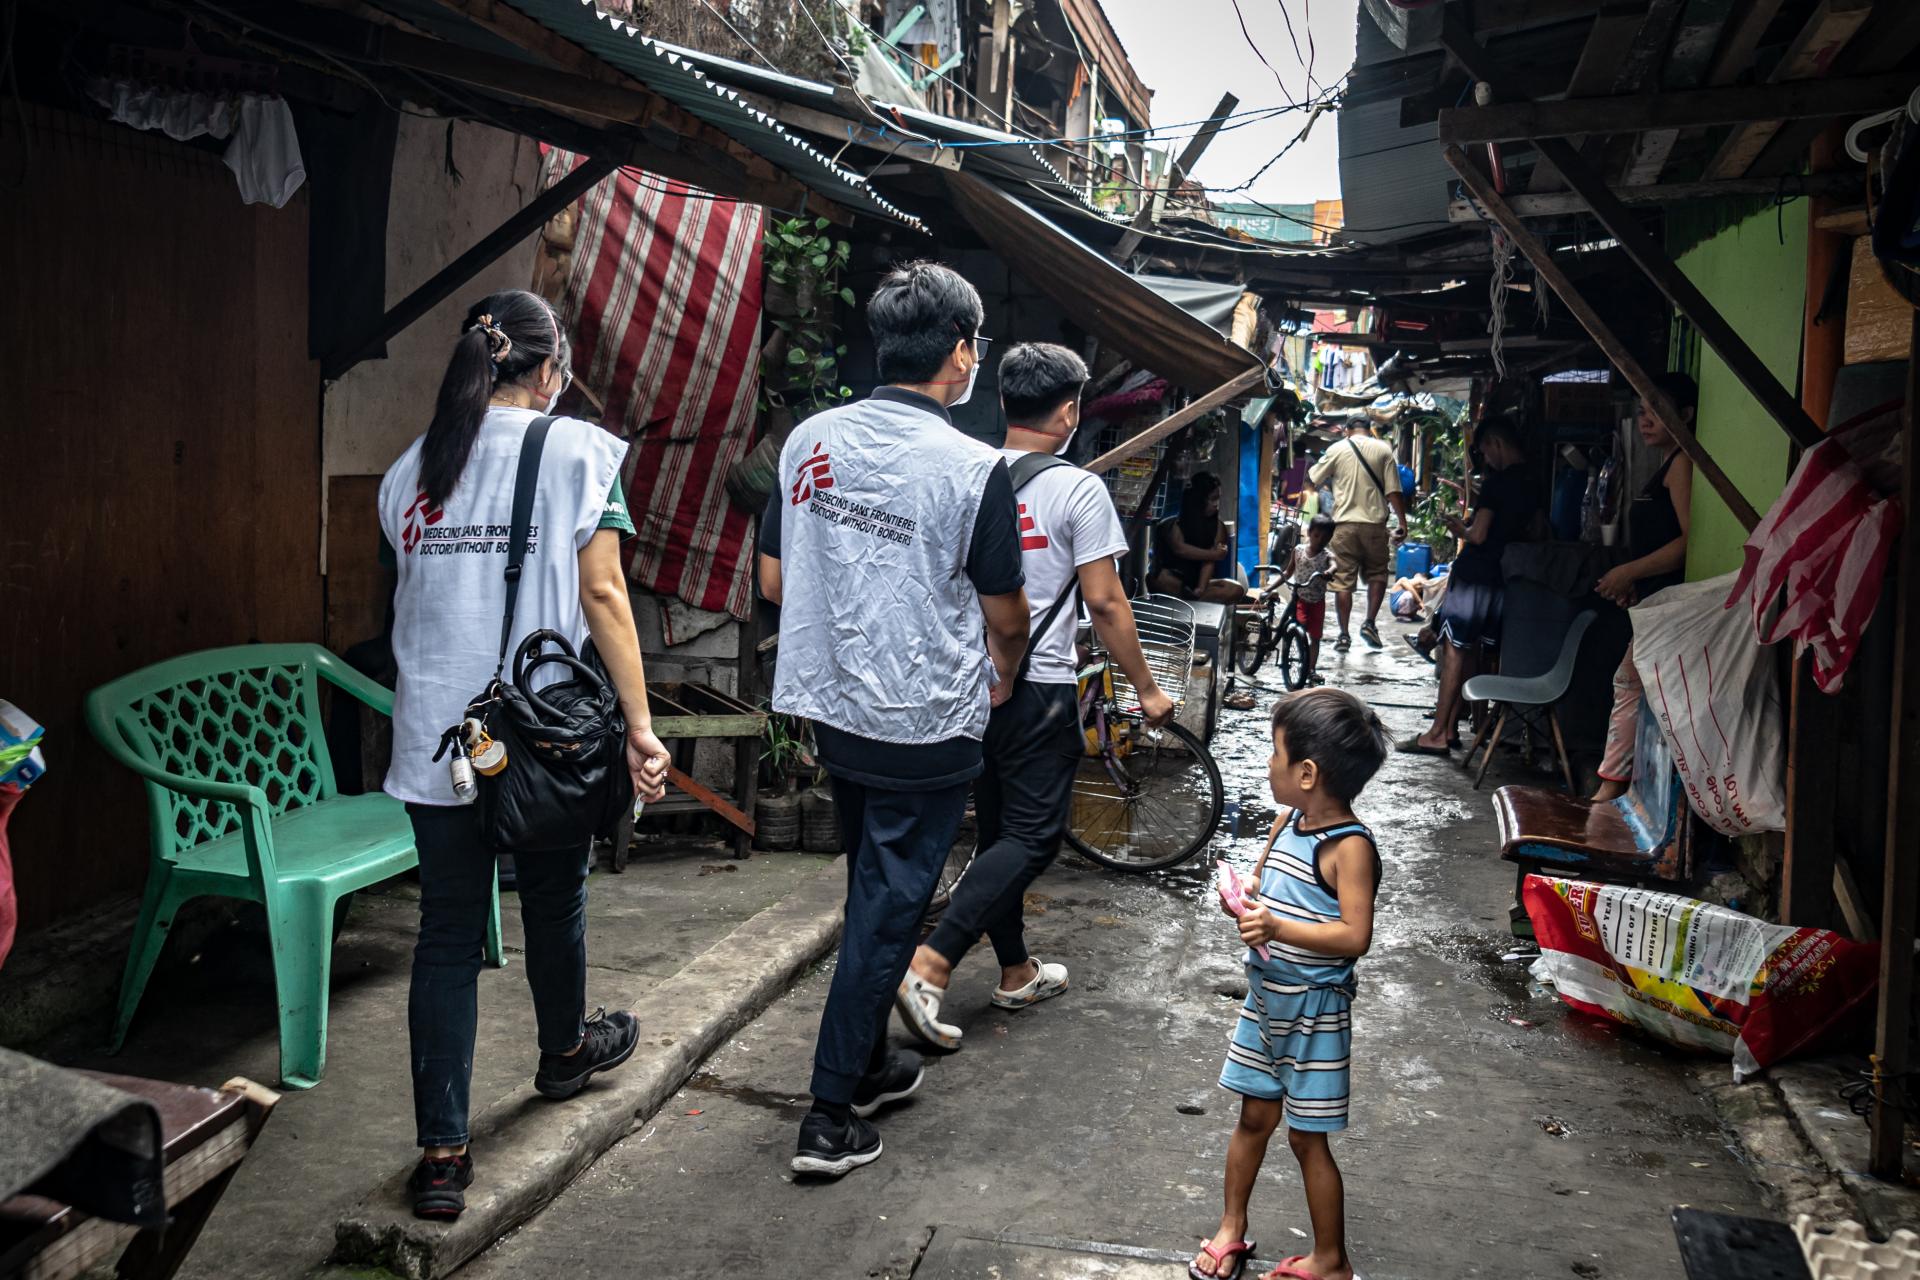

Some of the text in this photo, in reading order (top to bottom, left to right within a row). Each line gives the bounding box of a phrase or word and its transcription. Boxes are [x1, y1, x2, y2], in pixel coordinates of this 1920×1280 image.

[810, 502, 913, 546] DOCTORS WITHOUT BORDERS
[849, 502, 871, 518] SANS
[461, 525, 484, 537] SANS
[485, 525, 539, 537] FRONES
[420, 541, 537, 556] DOCTORS WITHOUT BORS
[1723, 773, 1752, 828] RM LOT
[1628, 914, 1636, 928] OF
[1625, 931, 1634, 959] DATE
[1647, 912, 1658, 967] MOISTURE
[1684, 936, 1697, 978] COOKING
